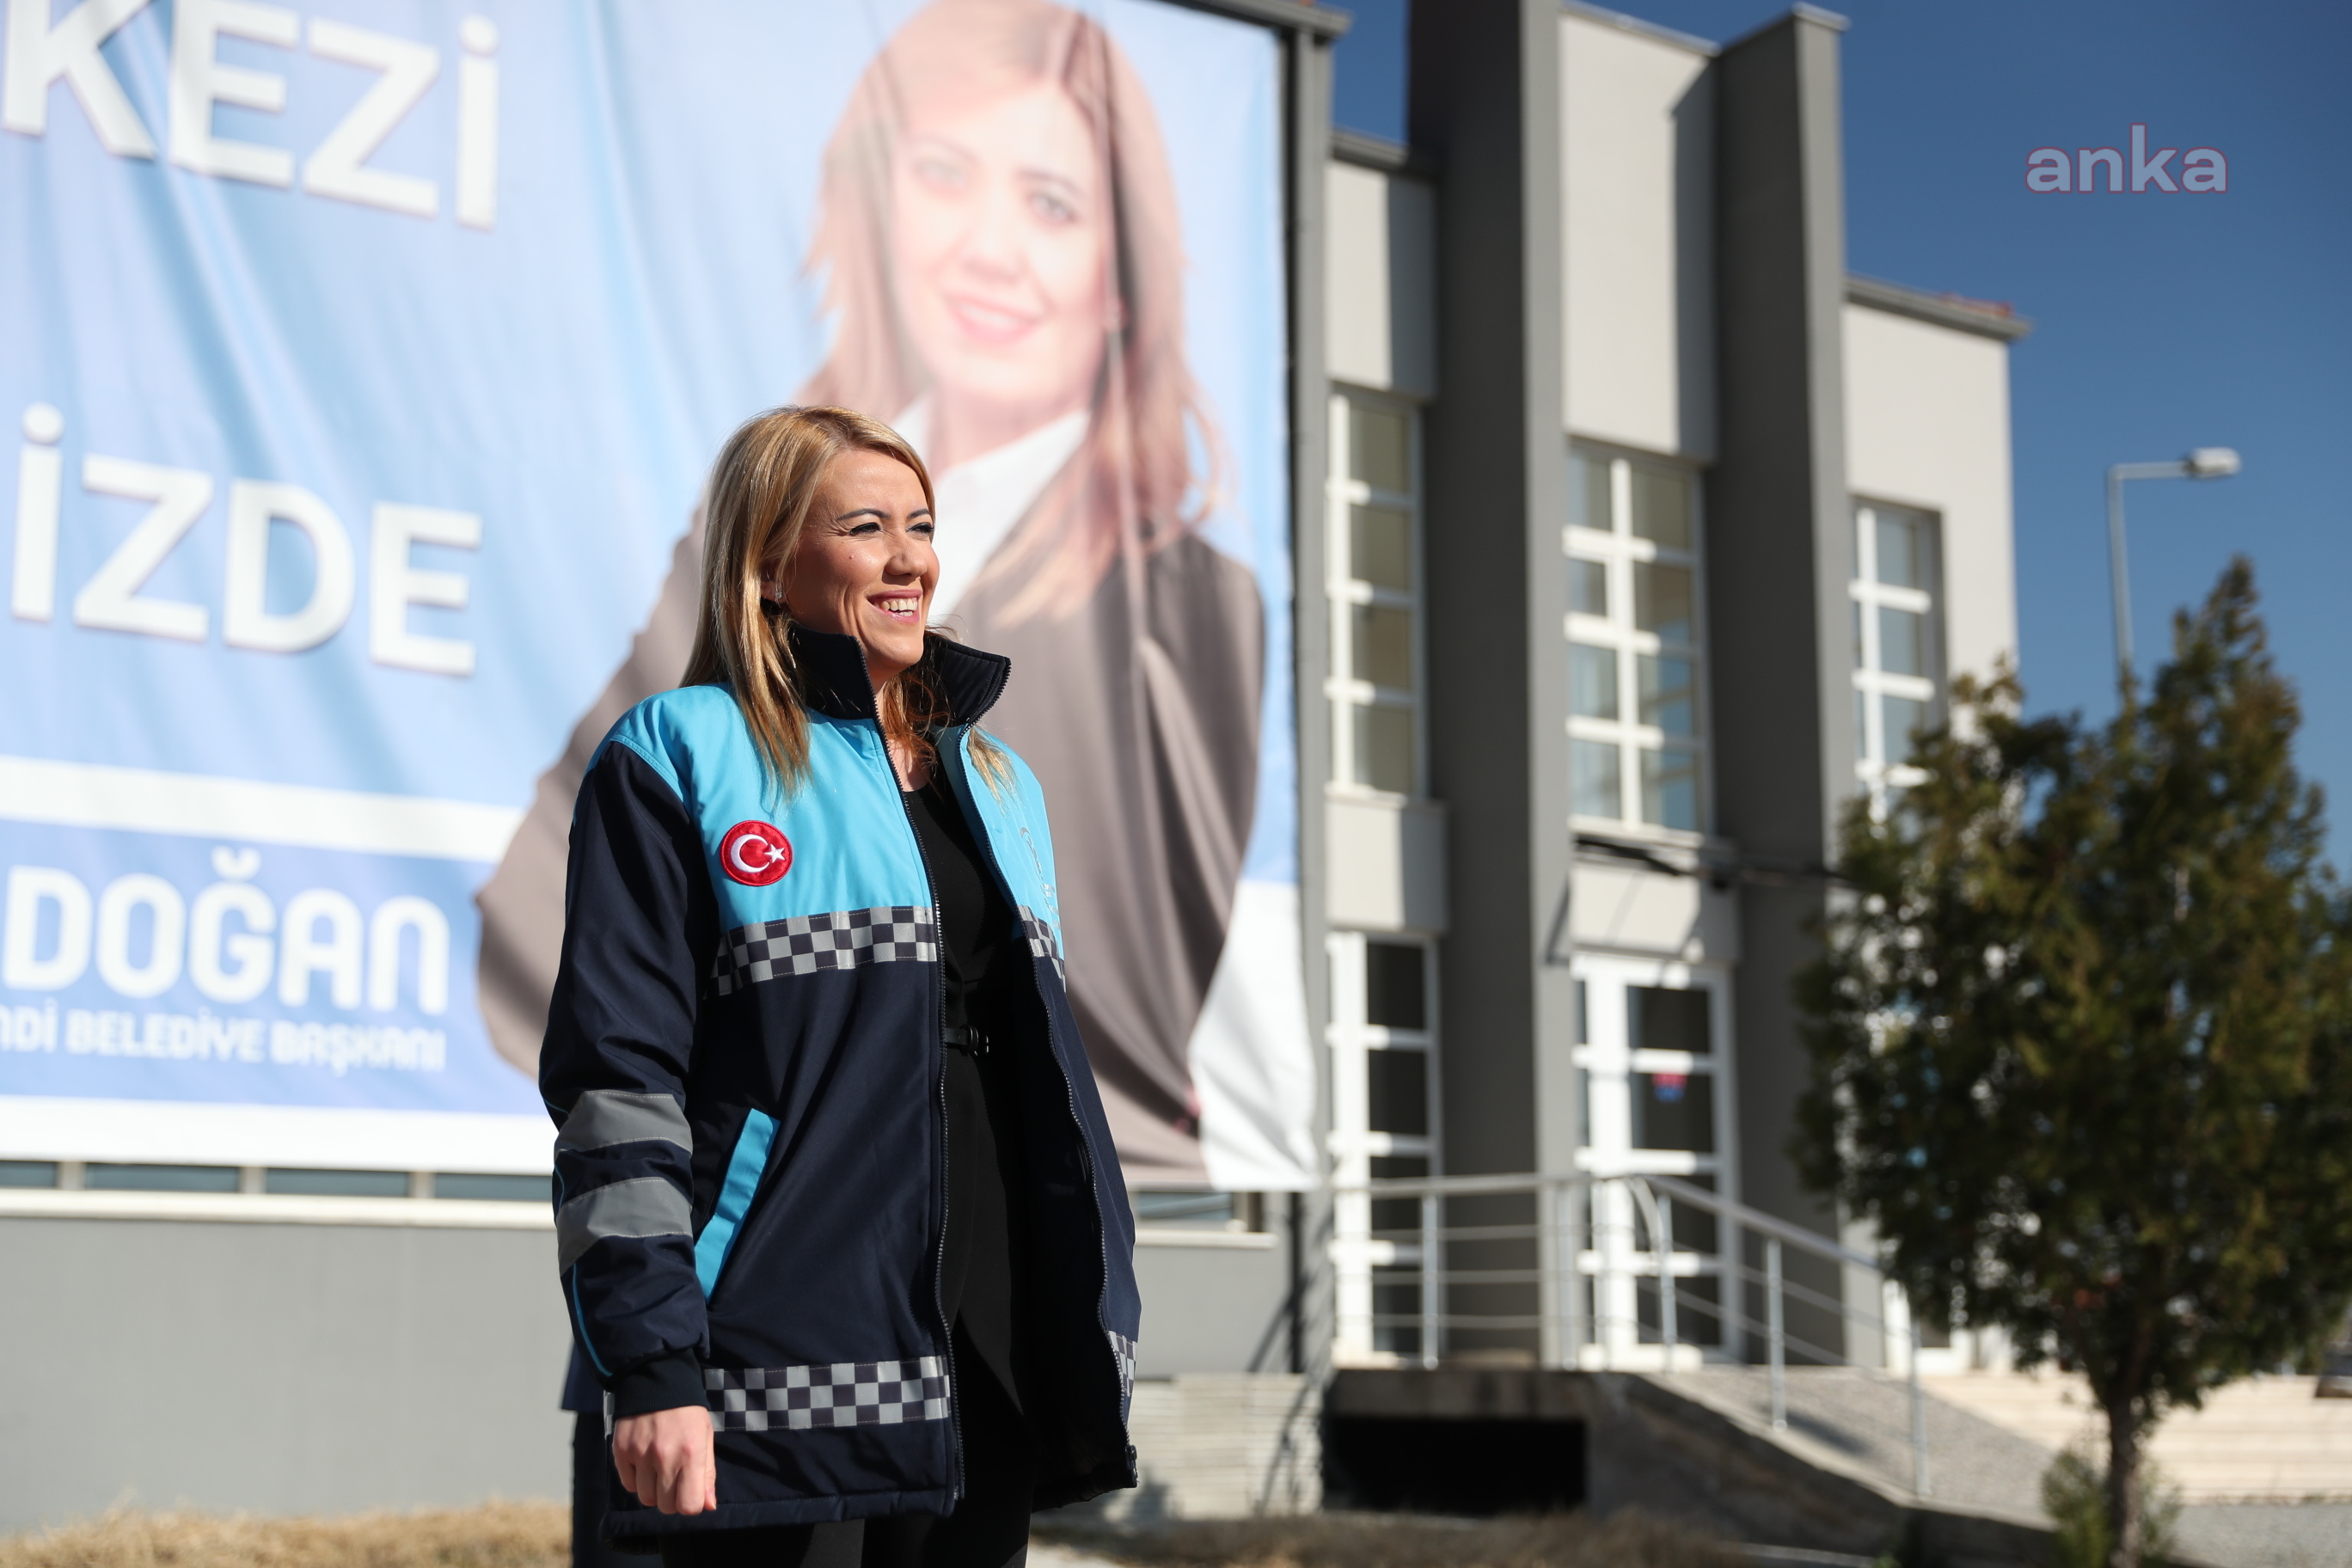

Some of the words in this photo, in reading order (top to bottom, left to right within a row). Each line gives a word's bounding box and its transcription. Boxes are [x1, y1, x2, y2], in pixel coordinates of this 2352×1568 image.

[3, 846, 450, 1015] DOĞAN
[66, 1007, 266, 1063] BELEDİYE
[270, 1020, 447, 1077] BAŞKANI
